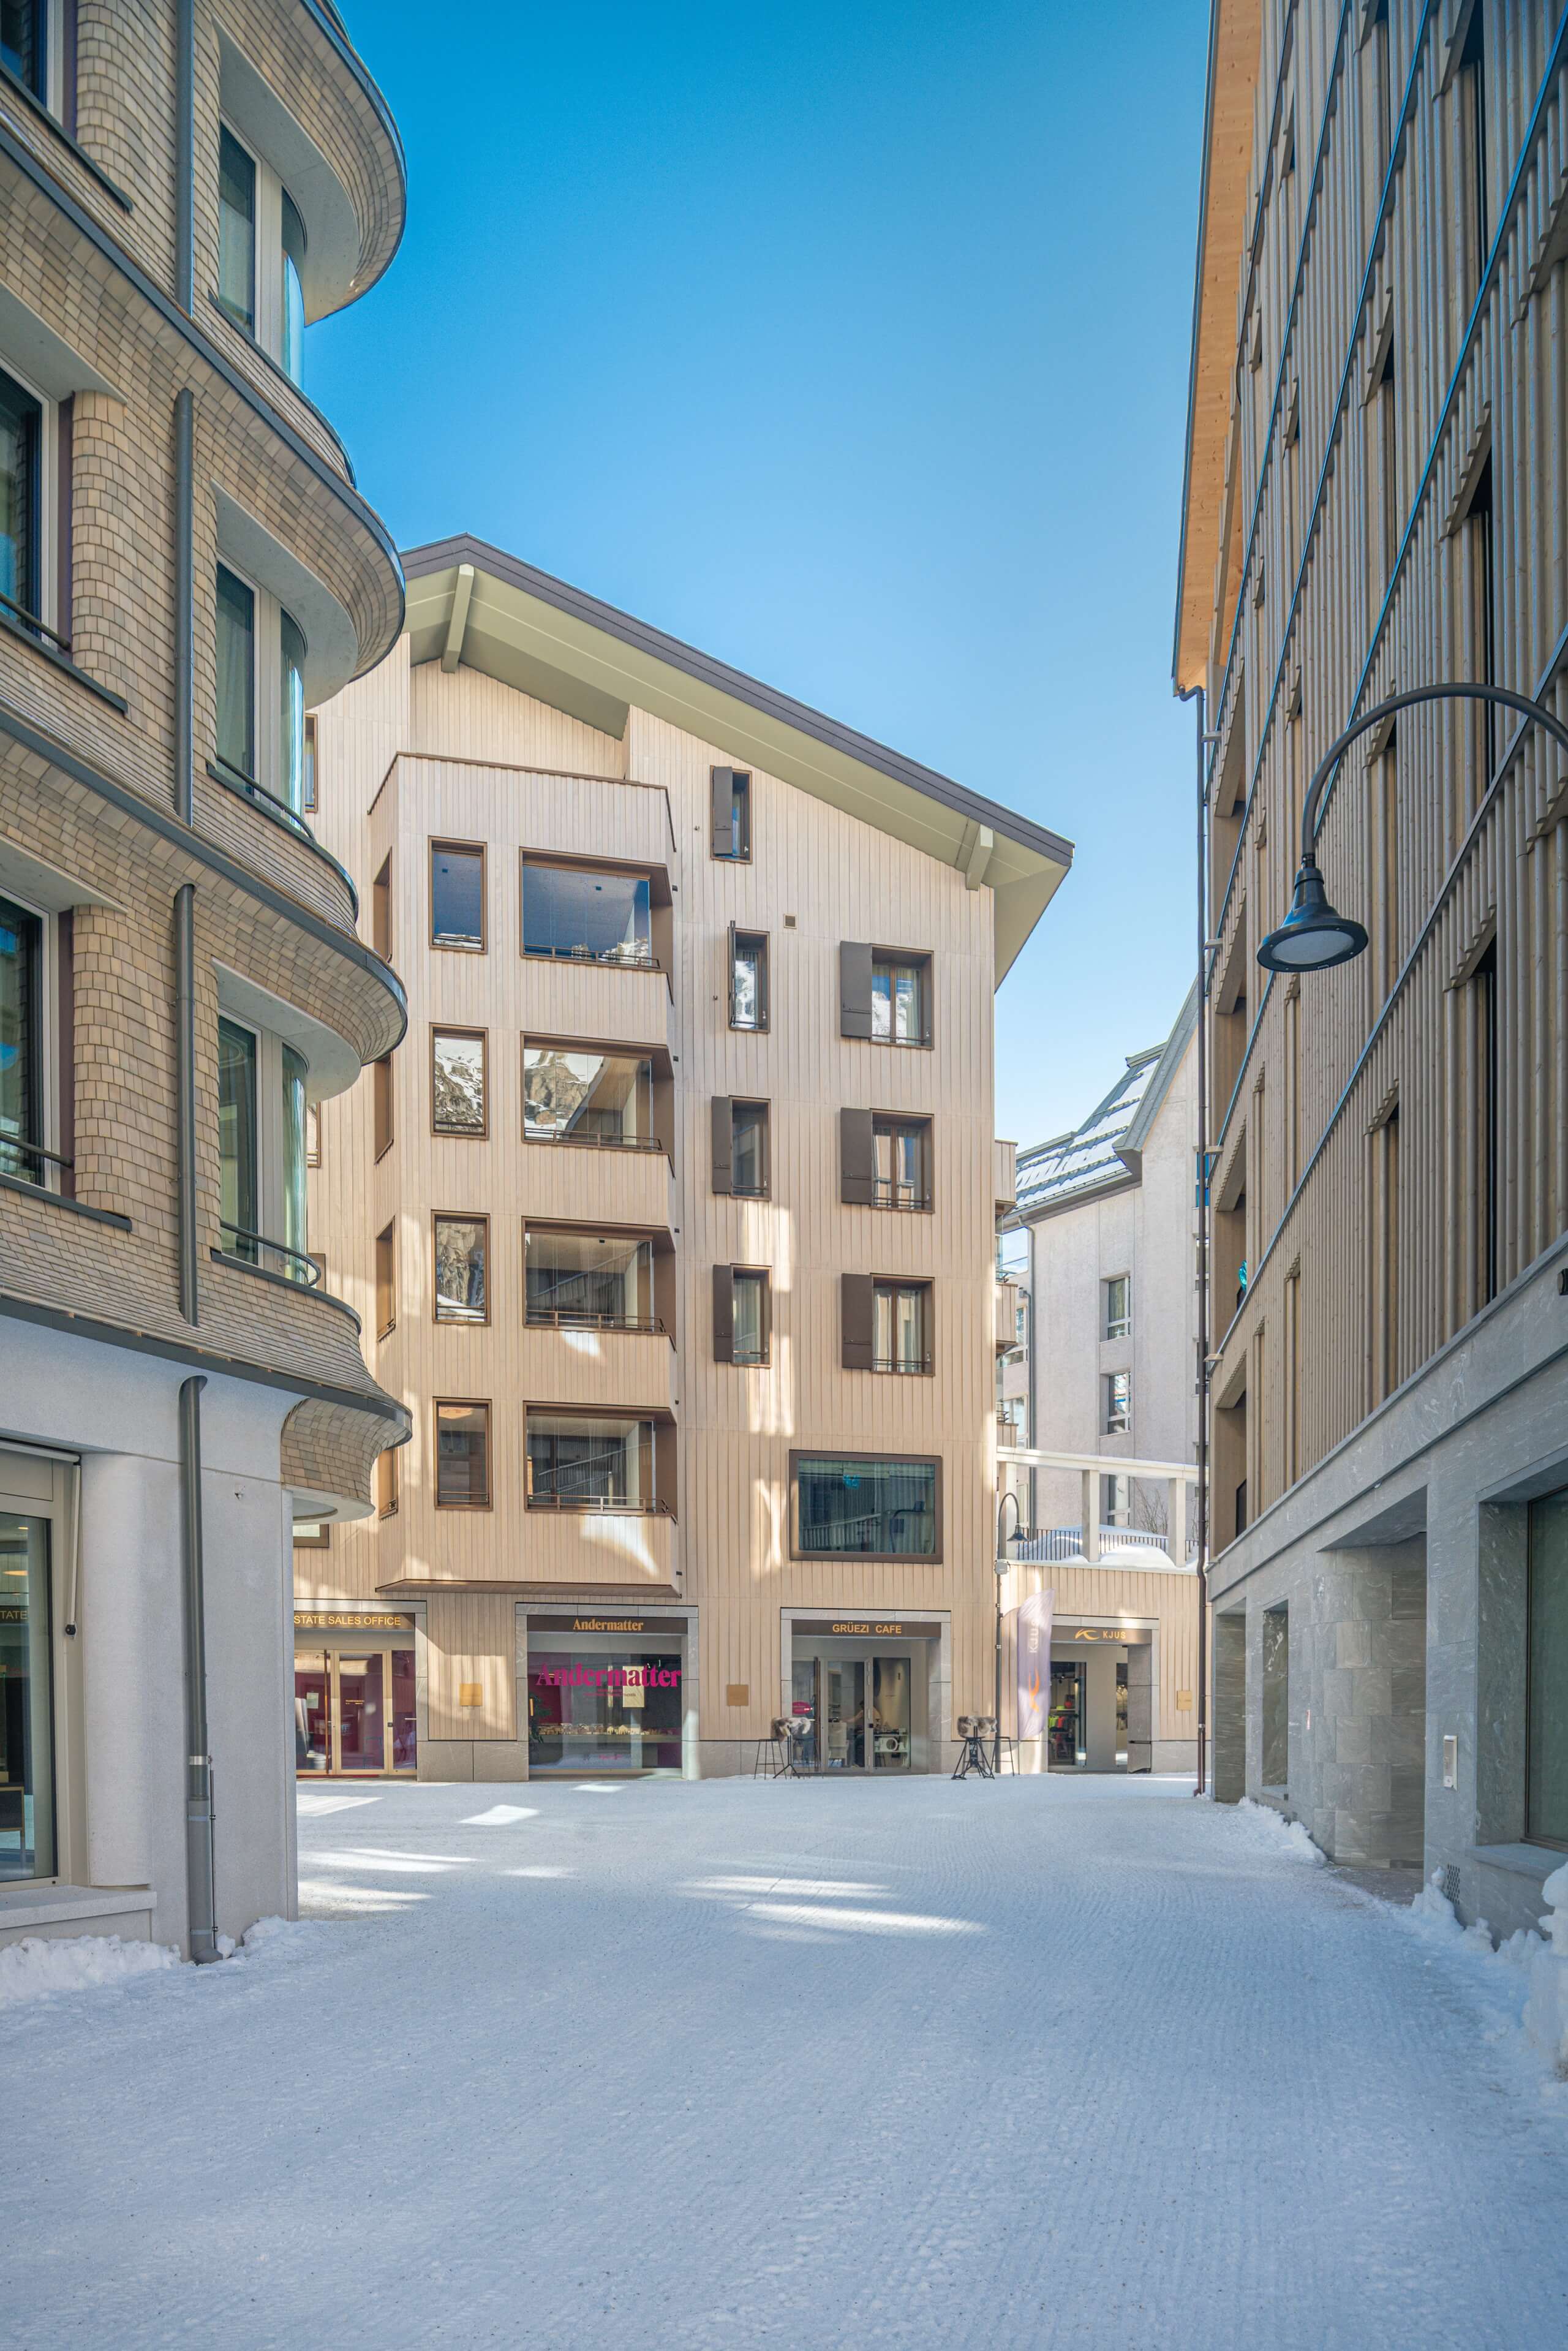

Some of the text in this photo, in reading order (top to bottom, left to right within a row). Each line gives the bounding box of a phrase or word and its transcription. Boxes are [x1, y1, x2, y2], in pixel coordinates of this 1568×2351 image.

[328, 1616, 361, 1625] SALES
[364, 1617, 401, 1625] OFFICE
[573, 1618, 643, 1631] Andermatter
[832, 1622, 902, 1634] GRÜEZI CAFE
[536, 1663, 682, 1687] Andermatter
